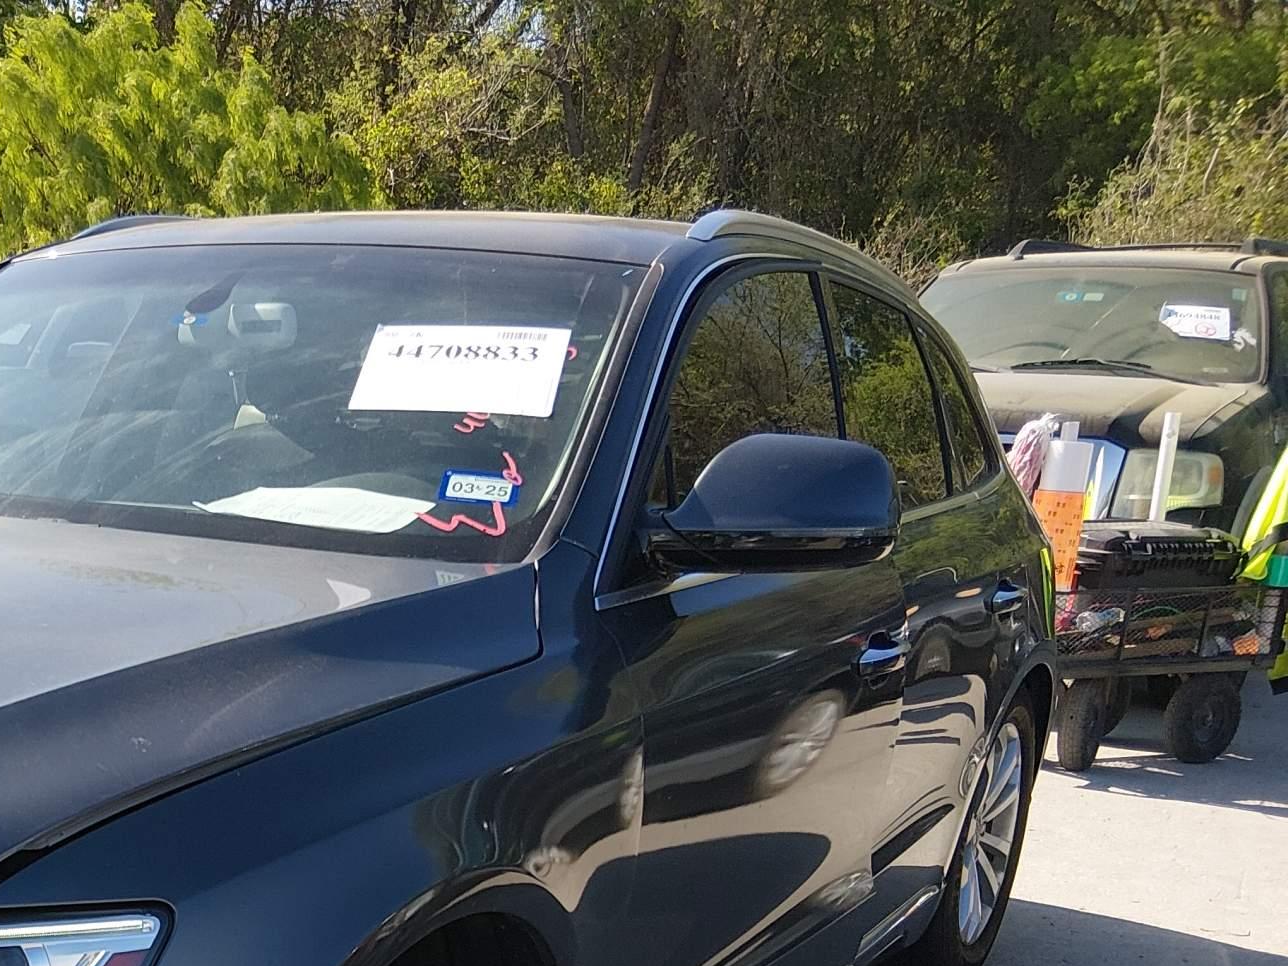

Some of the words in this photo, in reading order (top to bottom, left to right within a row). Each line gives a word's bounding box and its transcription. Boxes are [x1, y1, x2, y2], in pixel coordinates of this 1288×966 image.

[387, 343, 540, 363] 44708833
[451, 481, 475, 494] 03
[484, 484, 509, 497] 25
